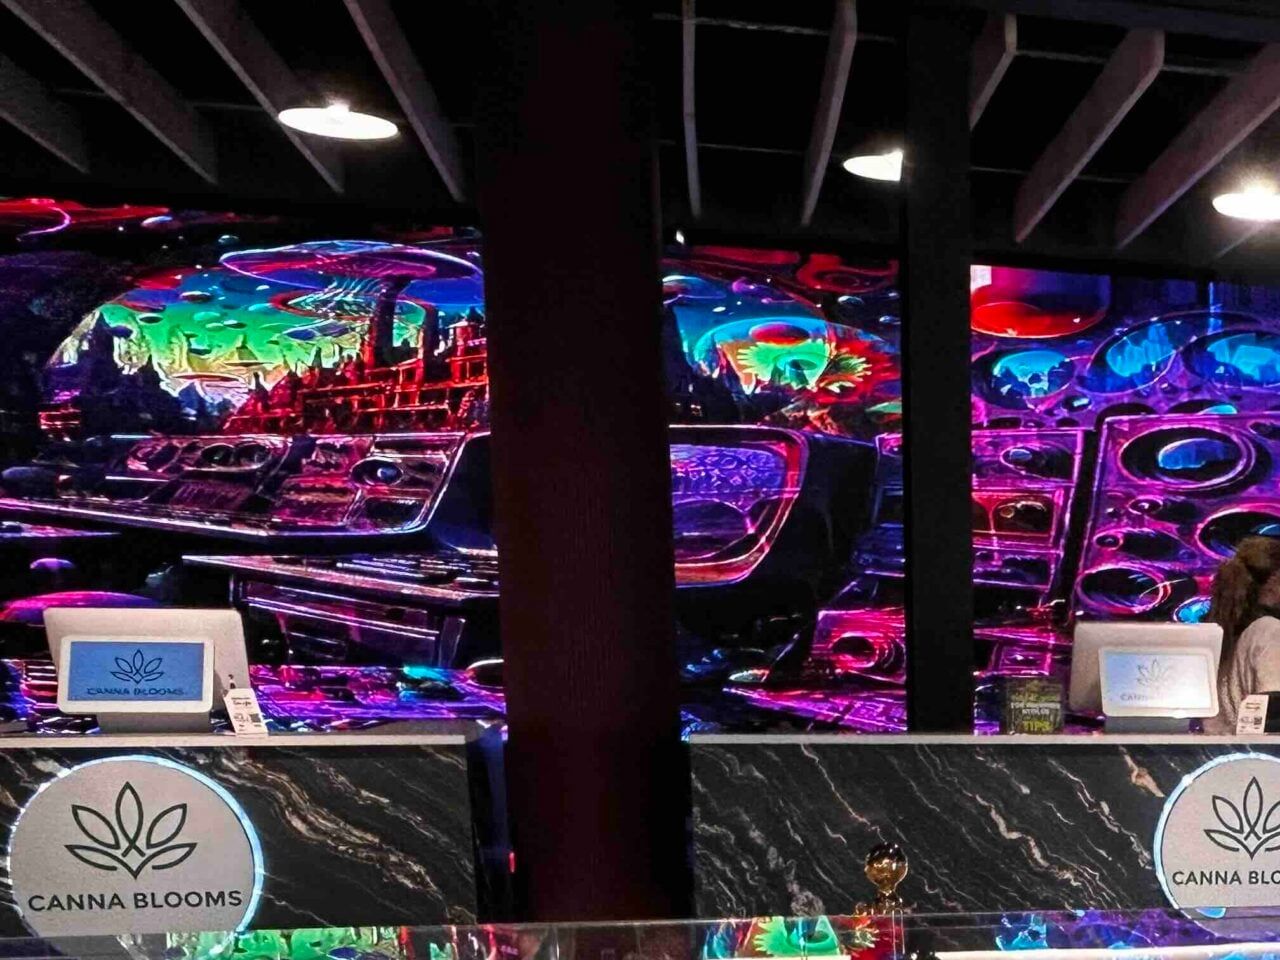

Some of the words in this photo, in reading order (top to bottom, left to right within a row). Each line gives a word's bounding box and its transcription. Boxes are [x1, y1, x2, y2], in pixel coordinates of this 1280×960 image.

[1171, 869, 1243, 886] CANNA
[27, 892, 126, 912] CANNA
[133, 890, 243, 910] BLOOMS
